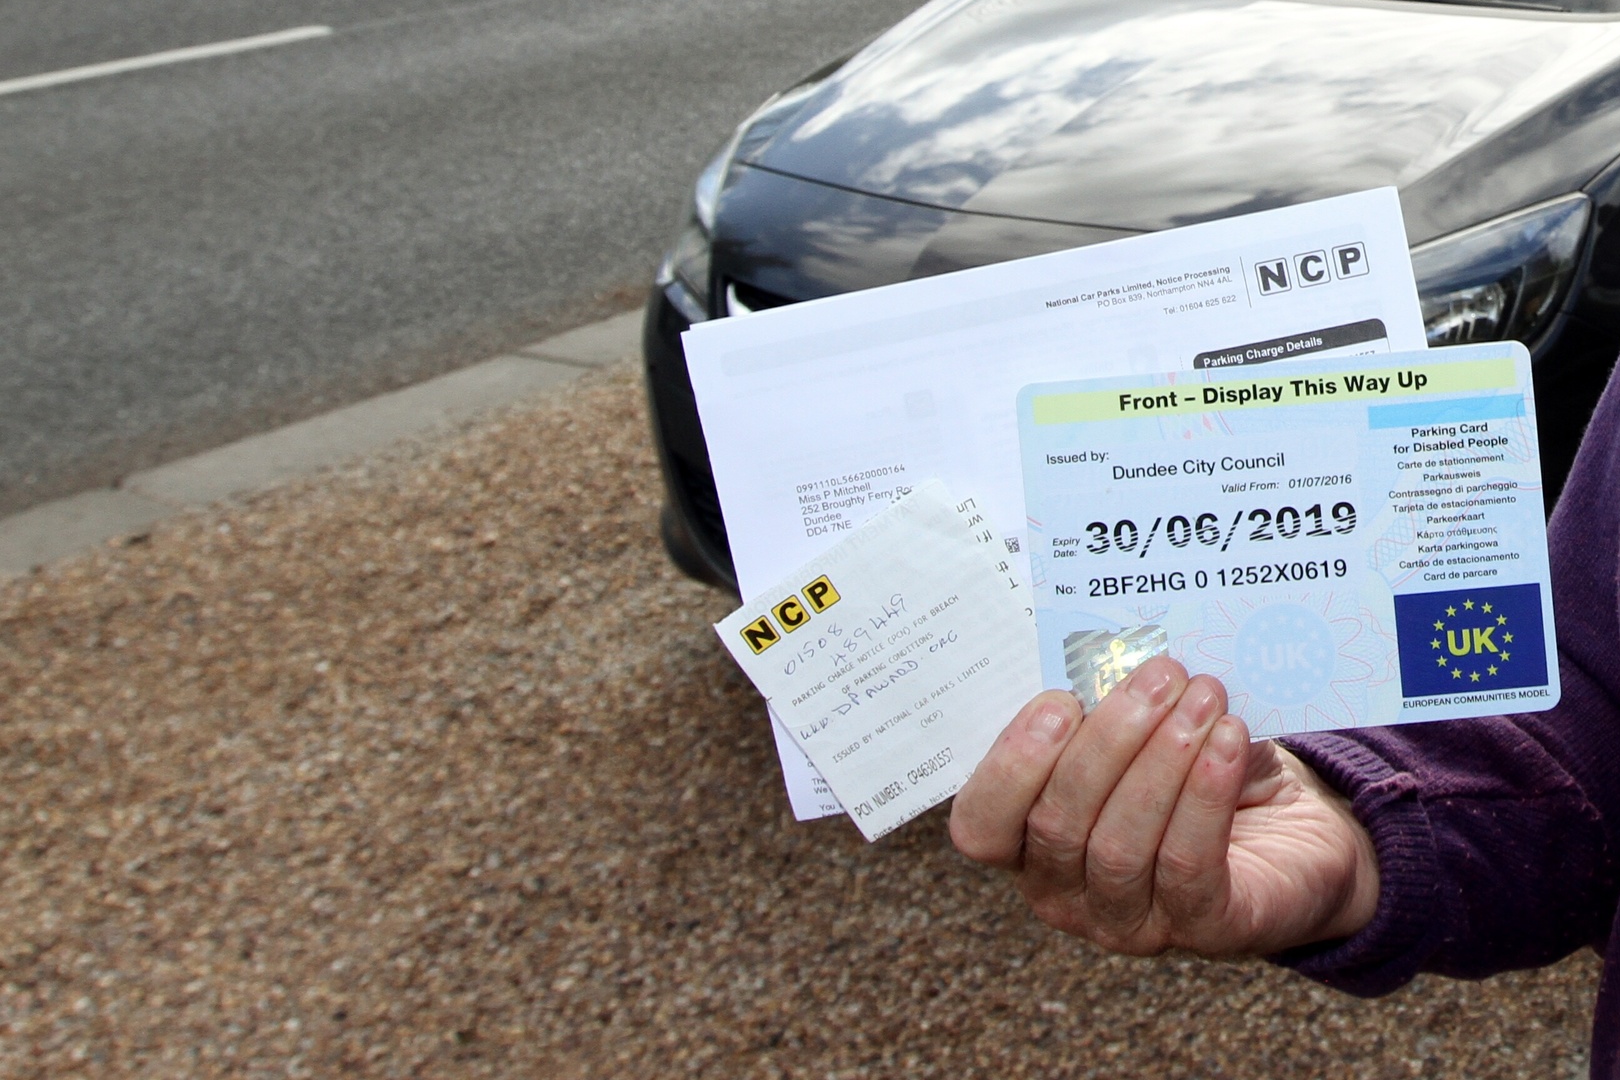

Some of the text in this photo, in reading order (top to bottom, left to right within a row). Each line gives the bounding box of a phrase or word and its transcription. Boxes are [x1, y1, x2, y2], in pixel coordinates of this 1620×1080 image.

[1260, 246, 1361, 292] NCP
[1046, 266, 1231, 308] National Car Parks Limited, Notice Processing
[1097, 300, 1110, 308] PO
[1112, 297, 1126, 305] Box
[1147, 283, 1196, 298] Northampton
[1197, 279, 1215, 289] NN4
[1217, 275, 1233, 284] 4AL
[1163, 294, 1237, 315] Tel: 01604 625 622
[1203, 336, 1323, 368] Parking Charge Details
[1119, 391, 1178, 412] Front
[1202, 383, 1283, 405] Display
[1290, 378, 1337, 397] This
[1343, 374, 1390, 394] Way
[1398, 370, 1428, 390] Up
[1411, 422, 1489, 438] Parking Card
[1393, 436, 1509, 454] for Disabled People
[1046, 451, 1109, 465] Issued by:
[1112, 453, 1285, 480] Dundee City Council
[1397, 454, 1505, 470] Carte de stationnement
[1221, 473, 1352, 494] Valid From: 01/07/2016
[1423, 471, 1481, 482] Parkausweis
[798, 482, 871, 505] Miss P Mitchell
[1388, 481, 1518, 499] Contrassegno di parcheggio
[801, 504, 820, 515] 252
[821, 495, 865, 512] Broughty
[867, 489, 893, 501] Ferry
[1392, 496, 1517, 514] Tarjeta de estacionamiento
[803, 512, 842, 527] Dundee
[1427, 512, 1485, 524] Parkeerkaart
[806, 520, 853, 538] DD4 7NE
[1085, 501, 1358, 558] 30/06/2019
[1052, 536, 1081, 548] Expiry
[1418, 540, 1498, 554] Karta parkingowa
[1053, 548, 1078, 559] Date:
[1399, 552, 1520, 569] Cartão de estacionamento
[1055, 558, 1348, 597] No: 2BF2HG 0 1252X0619
[1423, 569, 1498, 581] Card de parcare
[744, 581, 829, 651] NCP
[784, 623, 843, 676] 01508
[792, 594, 959, 707] PARKING CHARGE NOTICE (PCN) FOR BREACH
[1447, 626, 1499, 656] UK
[841, 631, 934, 695] OF PARKING CONDITIONS
[1260, 646, 1312, 671] UK
[1402, 689, 1550, 709] EUROPEAN COMMUNITIES MODEL
[832, 657, 991, 764] ISSUED BY NATIONAL CAR PARKS LIMITED
[920, 709, 945, 730] (NCP)
[813, 786, 828, 795] We
[853, 746, 955, 820] PCN NUMBER: CP46301557
[819, 803, 836, 812] You
[873, 823, 894, 840] Date
[896, 814, 906, 828] of
[907, 802, 928, 821] this
